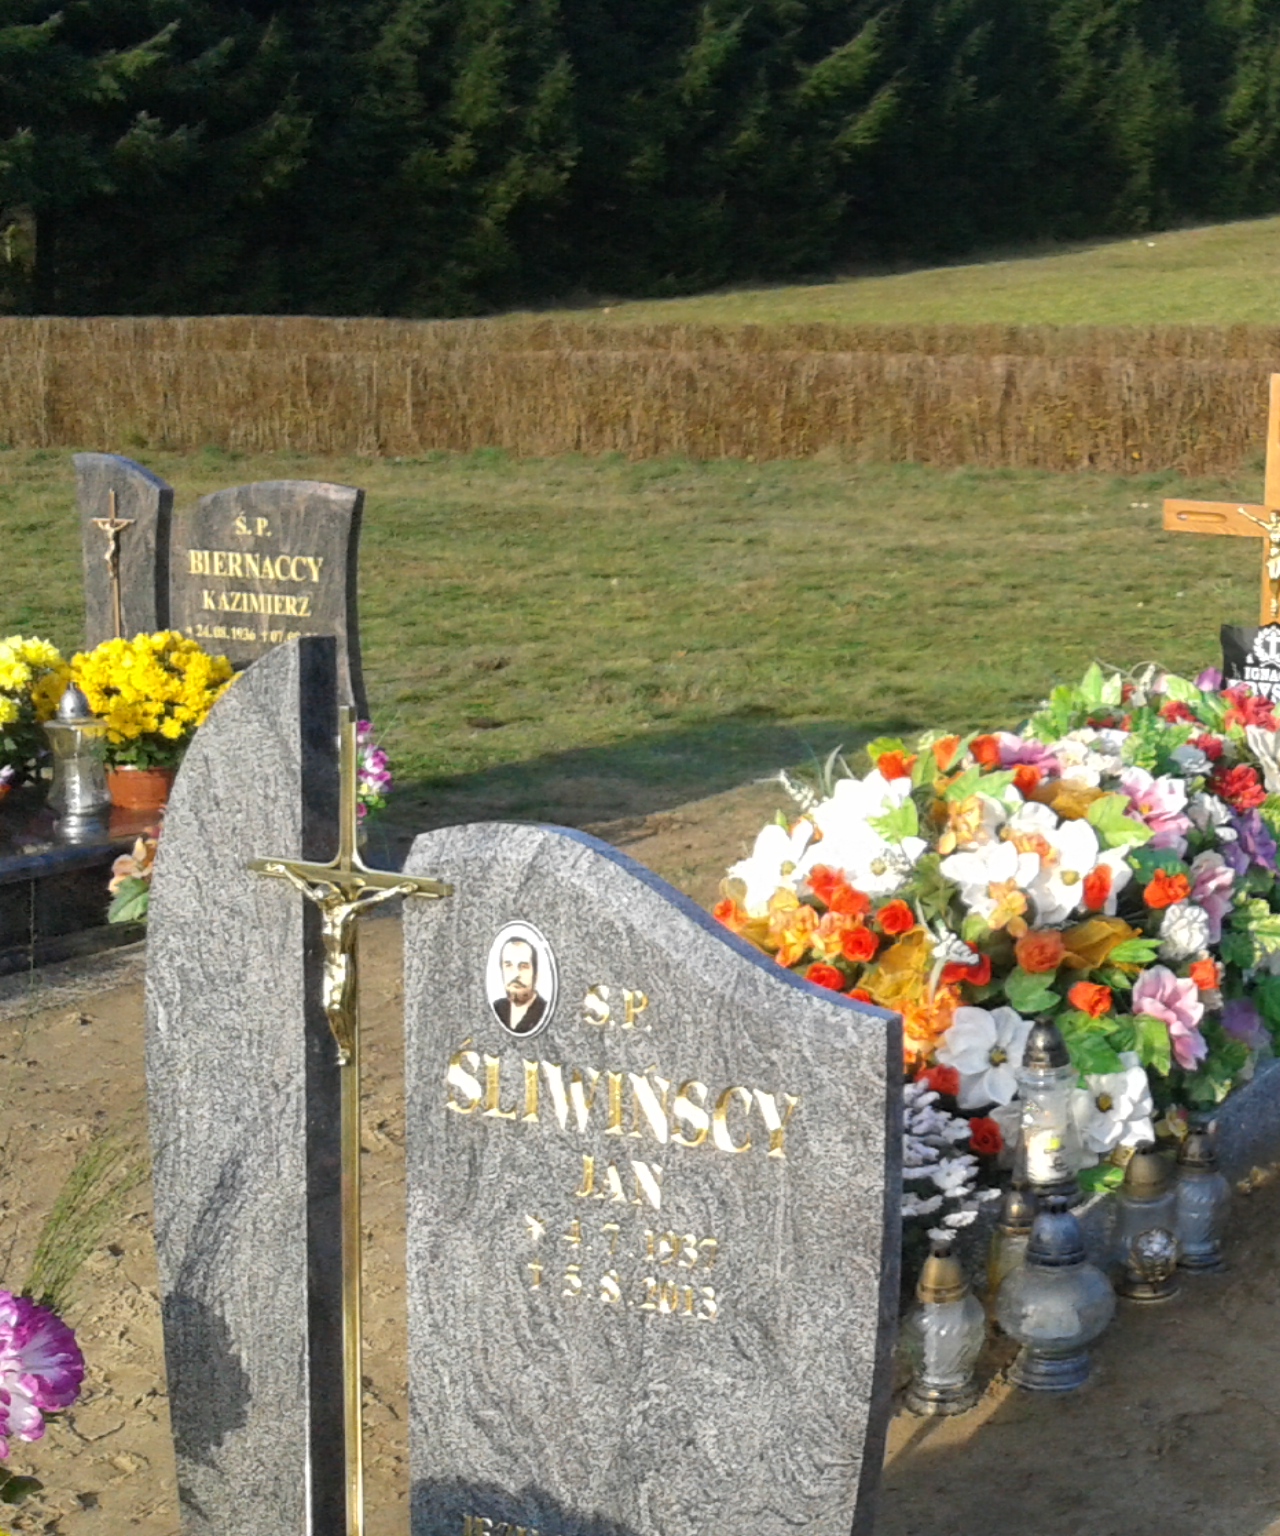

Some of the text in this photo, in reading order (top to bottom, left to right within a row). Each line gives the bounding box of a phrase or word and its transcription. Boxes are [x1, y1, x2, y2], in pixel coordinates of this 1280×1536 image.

[188, 549, 323, 582] BIERNACCY
[202, 589, 311, 617] KAZIMIERZ
[446, 1038, 799, 1160] ŚLIWIŃSCY
[575, 1154, 664, 1210] JAN
